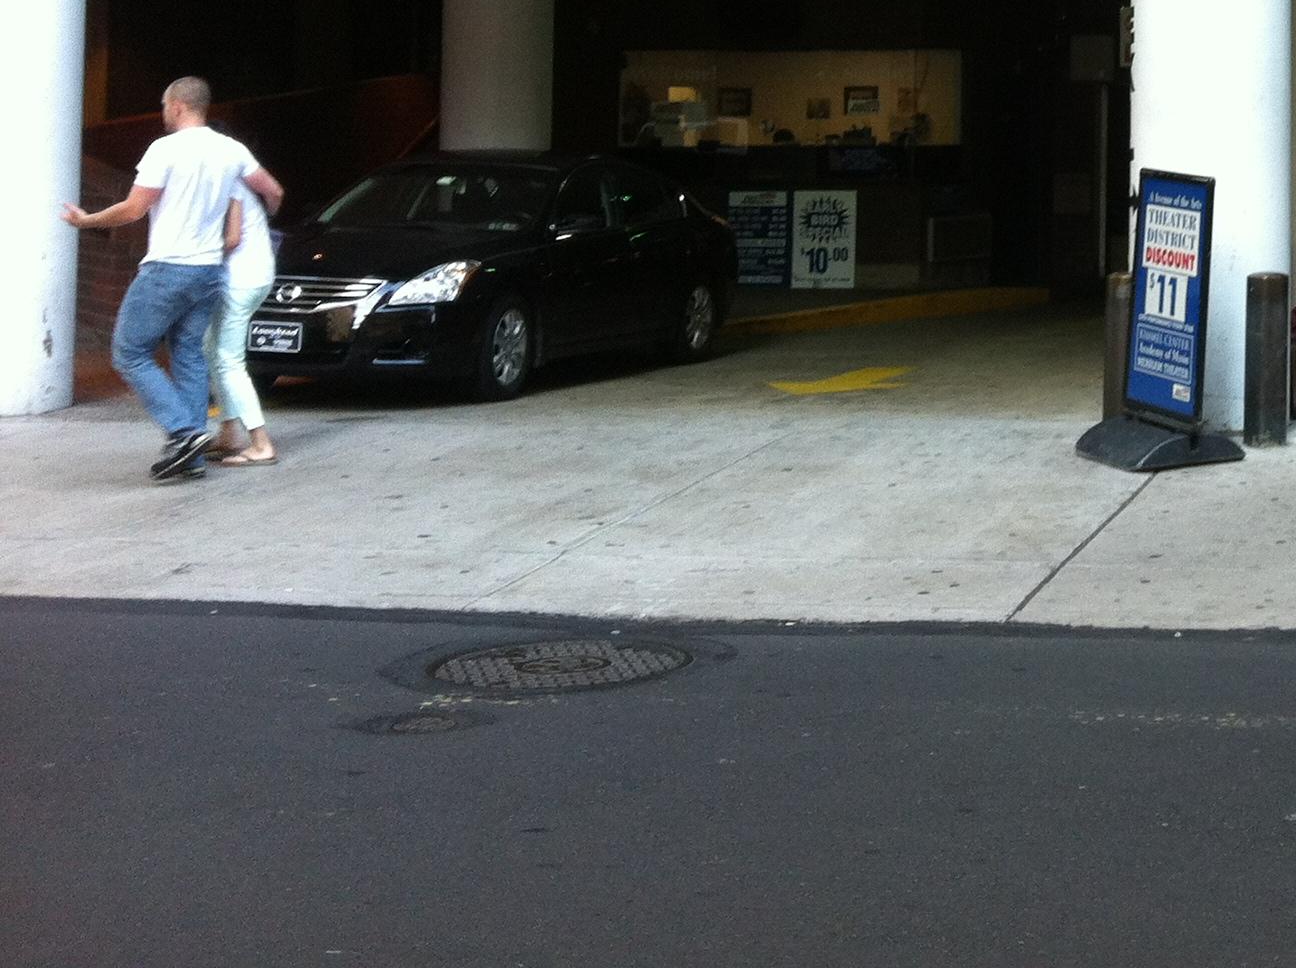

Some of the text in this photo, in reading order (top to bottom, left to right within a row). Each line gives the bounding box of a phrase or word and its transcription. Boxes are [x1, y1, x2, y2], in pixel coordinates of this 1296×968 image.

[1148, 208, 1197, 231] THEATER
[1147, 227, 1196, 251] DISTRICT
[1146, 246, 1195, 271] DISCOUNT
